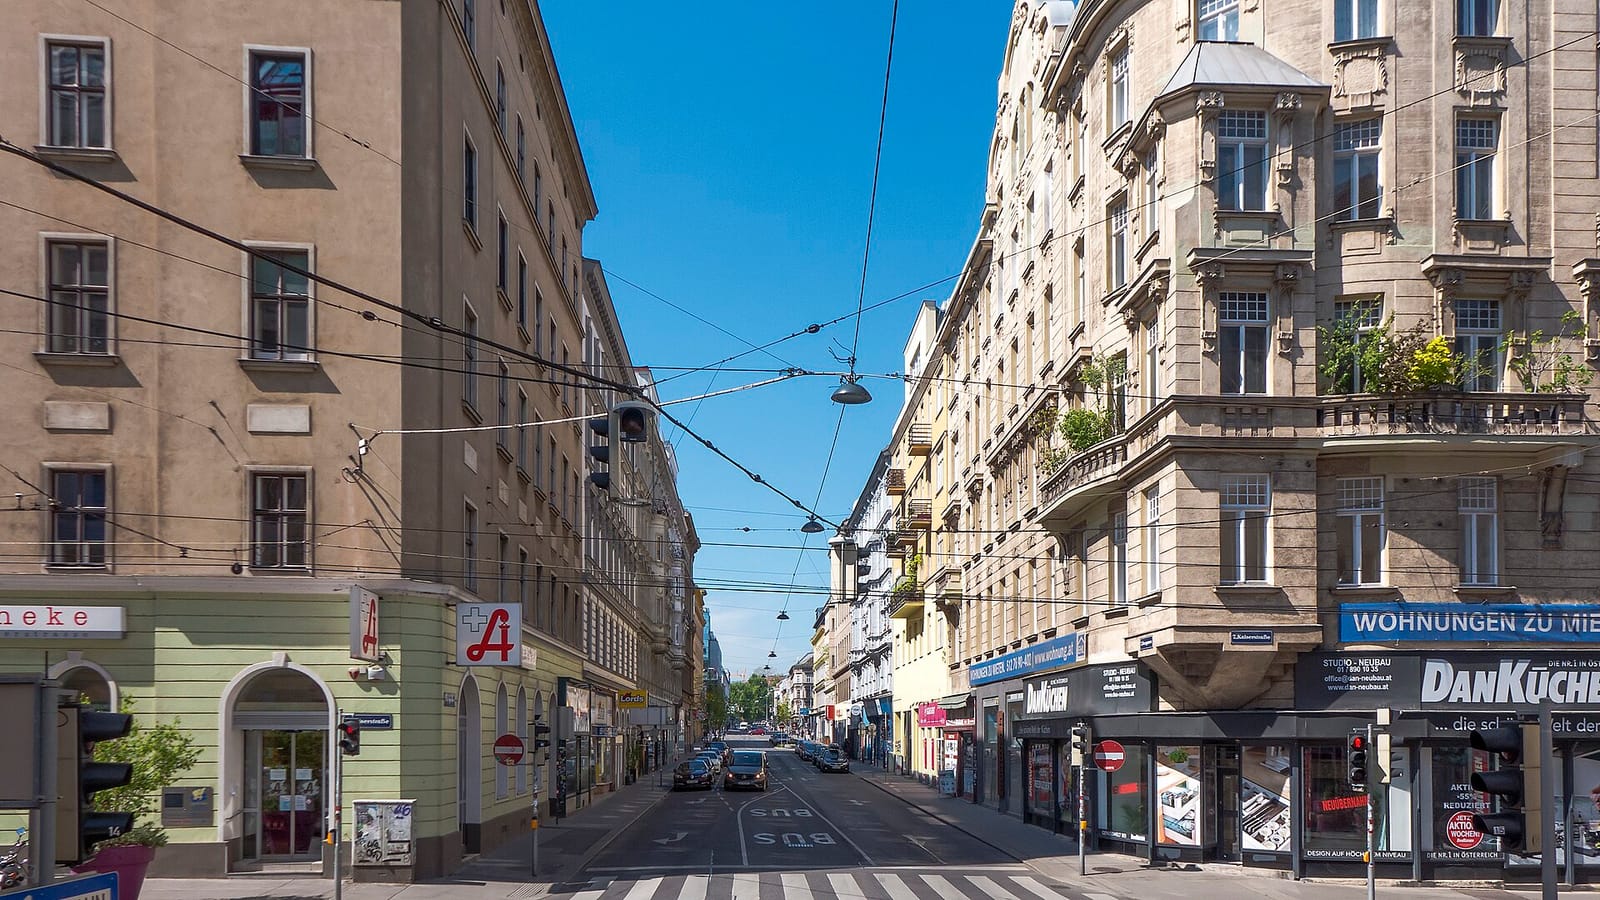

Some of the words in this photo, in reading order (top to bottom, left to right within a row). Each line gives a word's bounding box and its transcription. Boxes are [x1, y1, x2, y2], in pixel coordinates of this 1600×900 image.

[1353, 612, 1516, 632] WOHNUNGEN
[1523, 613, 1553, 632] ZU
[1323, 659, 1352, 667] STUDIO
[1358, 658, 1391, 667] NEUBAU
[1324, 675, 1392, 683] office@dan-neubau.at
[1453, 716, 1476, 731] die
[1550, 717, 1571, 732] elt
[750, 808, 813, 817] BUS
[1449, 821, 1474, 830] AKTIO
[108, 826, 120, 836] 14
[753, 833, 837, 845] BUS
[1460, 851, 1498, 859] ÖSTERREICH
